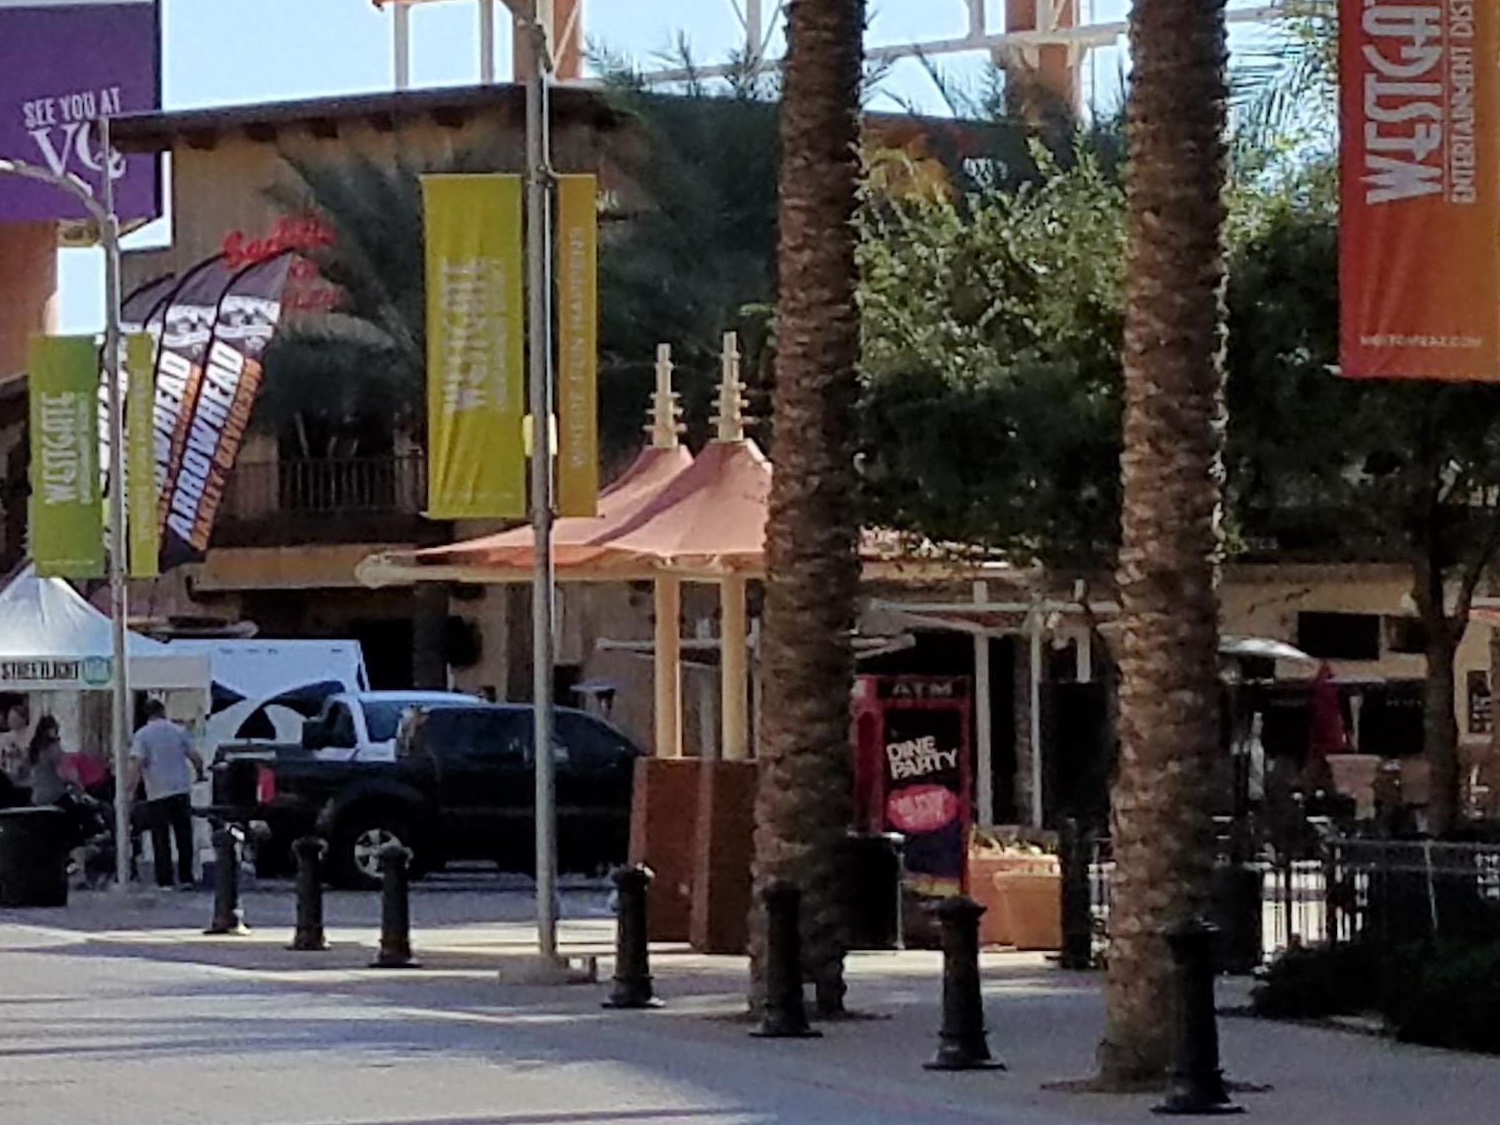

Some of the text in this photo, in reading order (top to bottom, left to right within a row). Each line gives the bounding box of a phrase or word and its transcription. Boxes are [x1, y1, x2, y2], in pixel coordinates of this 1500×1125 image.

[23, 87, 121, 128] SEE YOU AT
[1450, 41, 1478, 204] ENTERTAINMENT
[41, 391, 76, 504] WESTGATE
[167, 340, 244, 542] ARROWHEAD
[892, 682, 953, 697] ATM
[887, 736, 936, 762] DINE
[891, 748, 958, 780] PARTY
